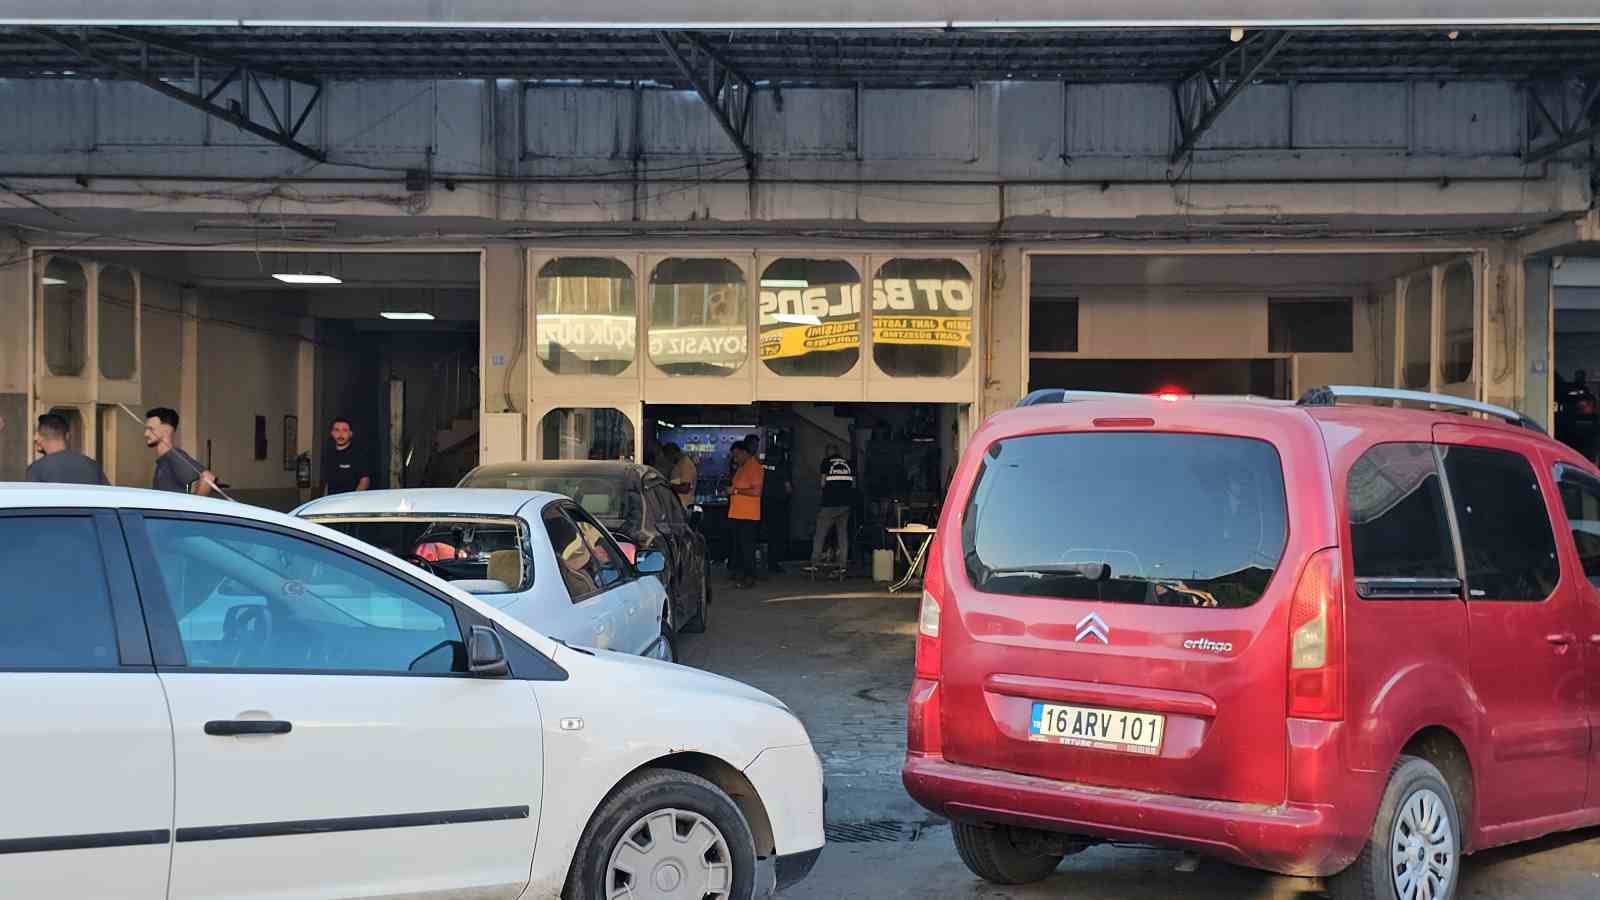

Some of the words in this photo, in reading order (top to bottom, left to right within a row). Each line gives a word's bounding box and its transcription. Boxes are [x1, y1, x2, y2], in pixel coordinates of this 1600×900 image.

[1047, 708, 1068, 733] 16
[1071, 711, 1112, 738] ARV
[1119, 715, 1157, 743] 101
